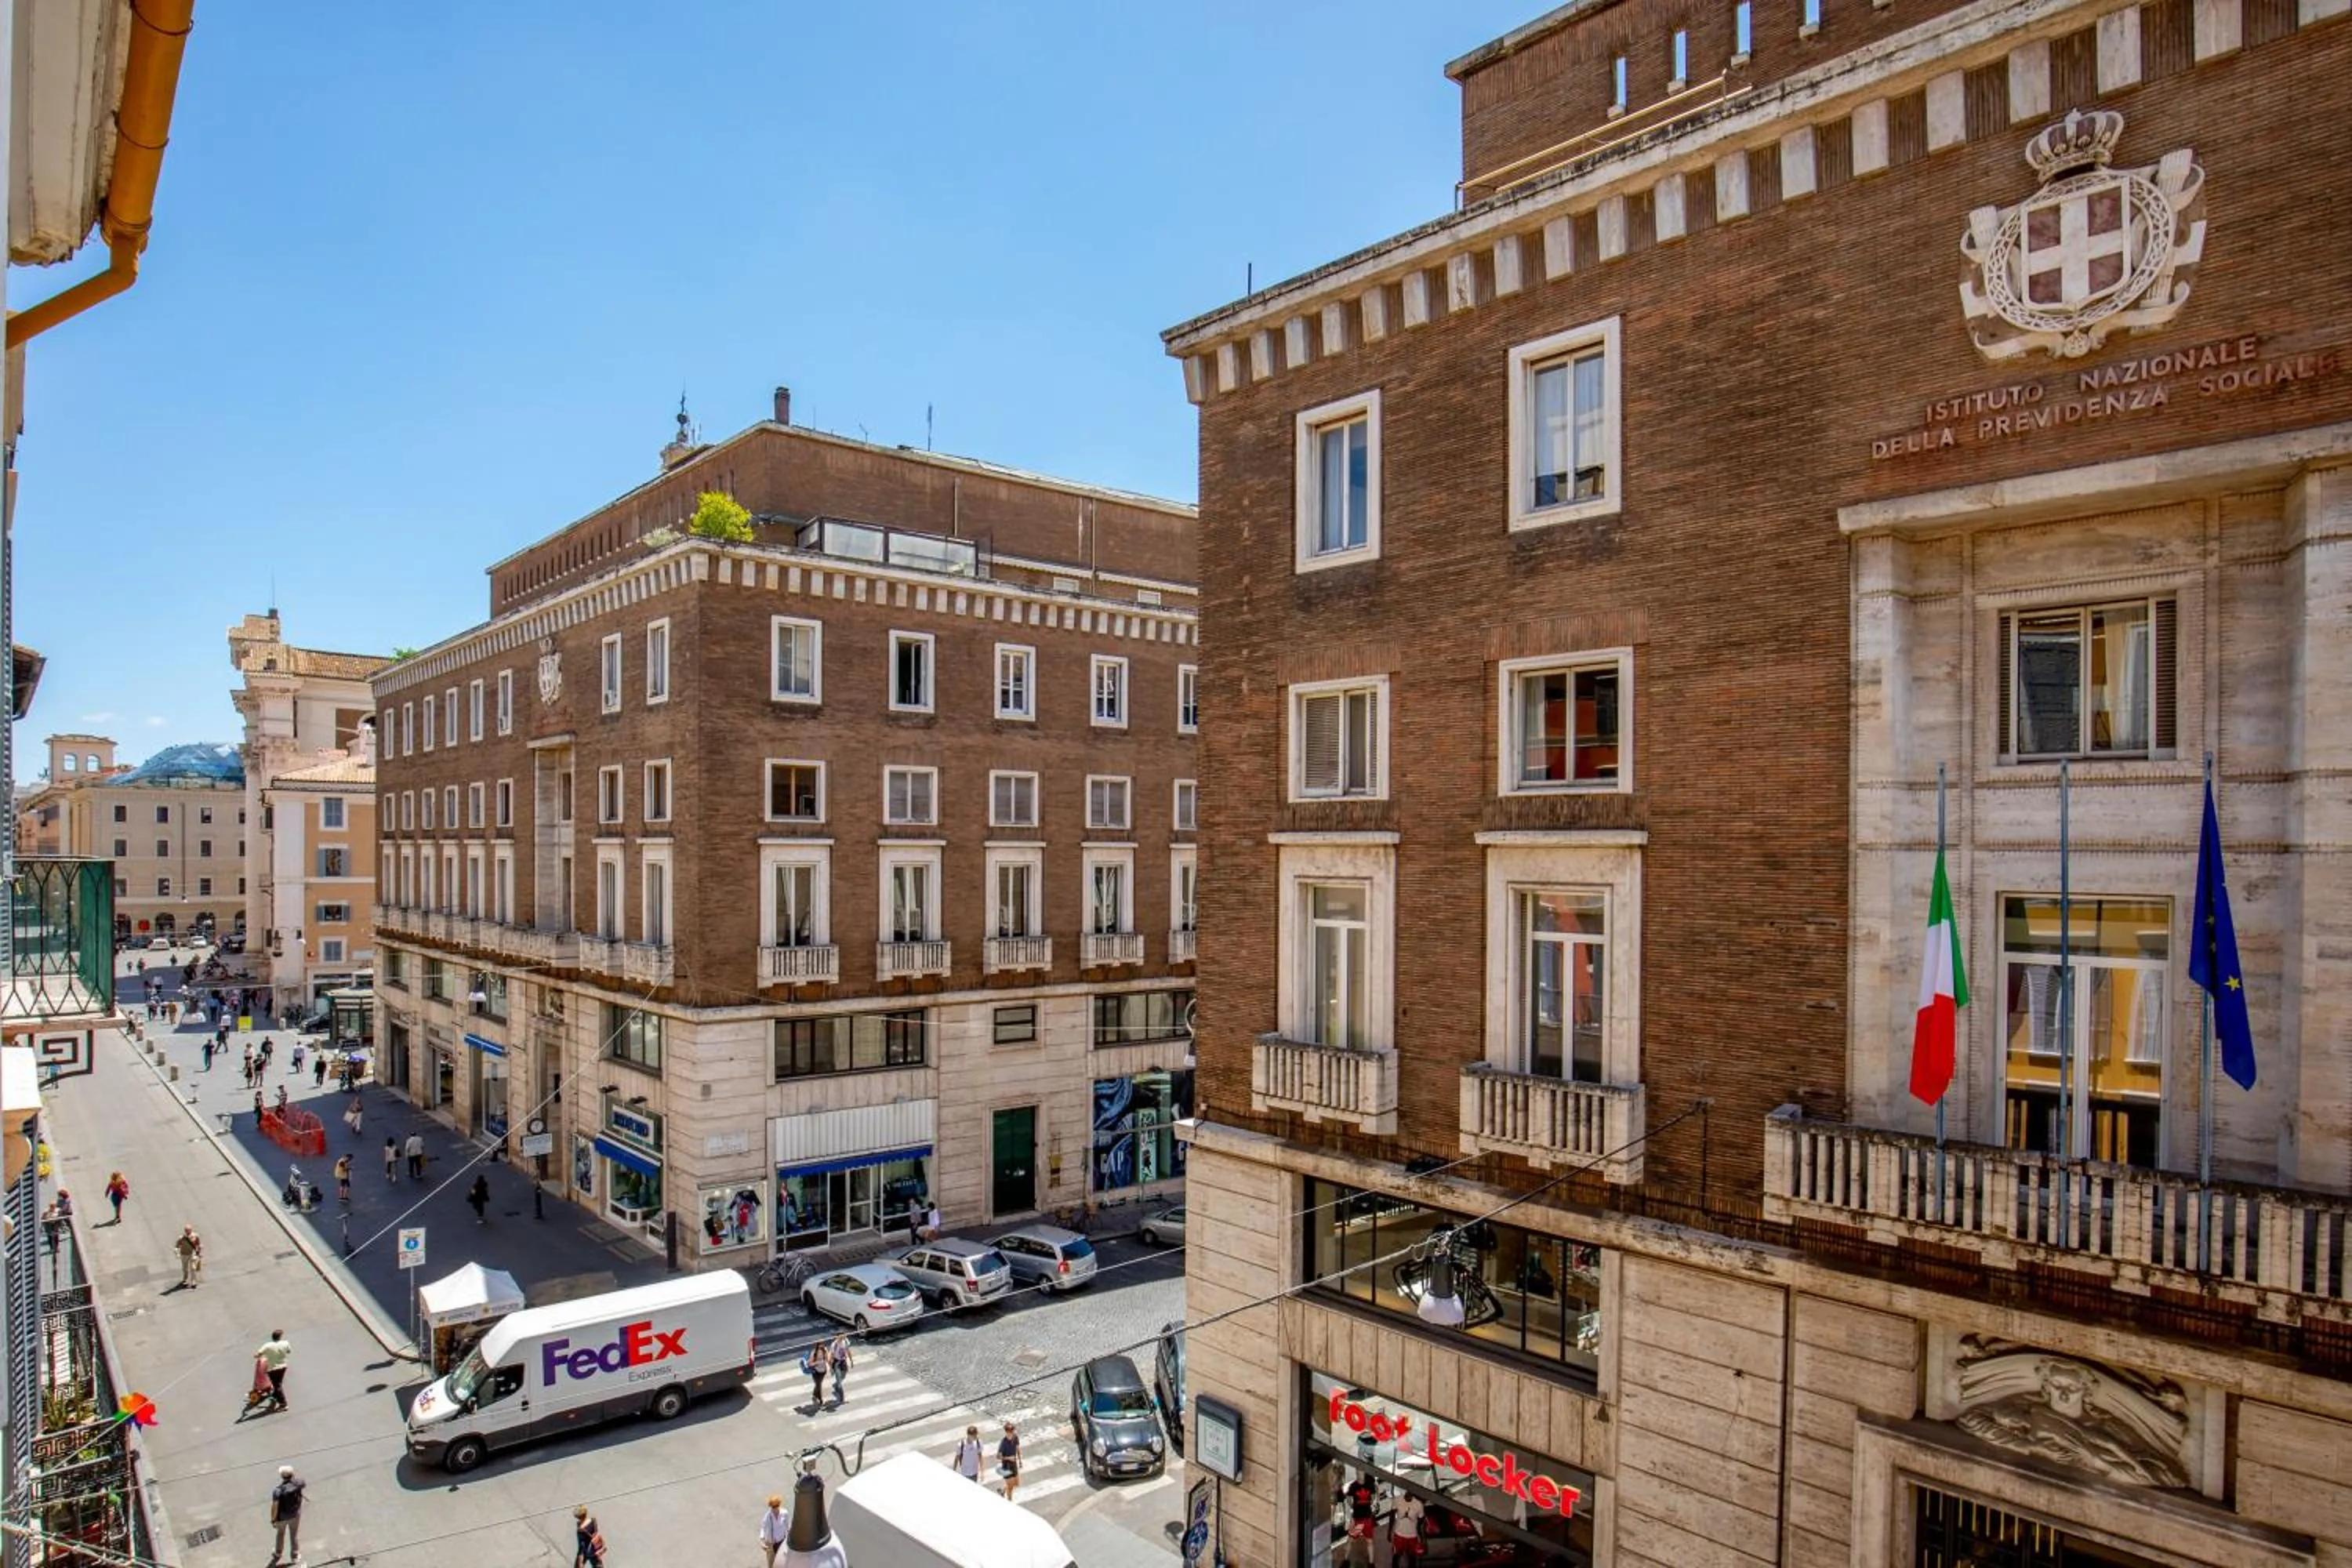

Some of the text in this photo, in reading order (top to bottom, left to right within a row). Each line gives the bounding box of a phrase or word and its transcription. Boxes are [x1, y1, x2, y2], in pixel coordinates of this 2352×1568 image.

[1872, 354, 2336, 459] DELLA PREVIDENZA SOCIALE
[1926, 336, 2257, 422] ISTITUTO NAZIONALE
[542, 1320, 688, 1387] FedEx
[628, 1365, 673, 1382] Express
[1329, 1386, 1581, 1519] Foot Locker
